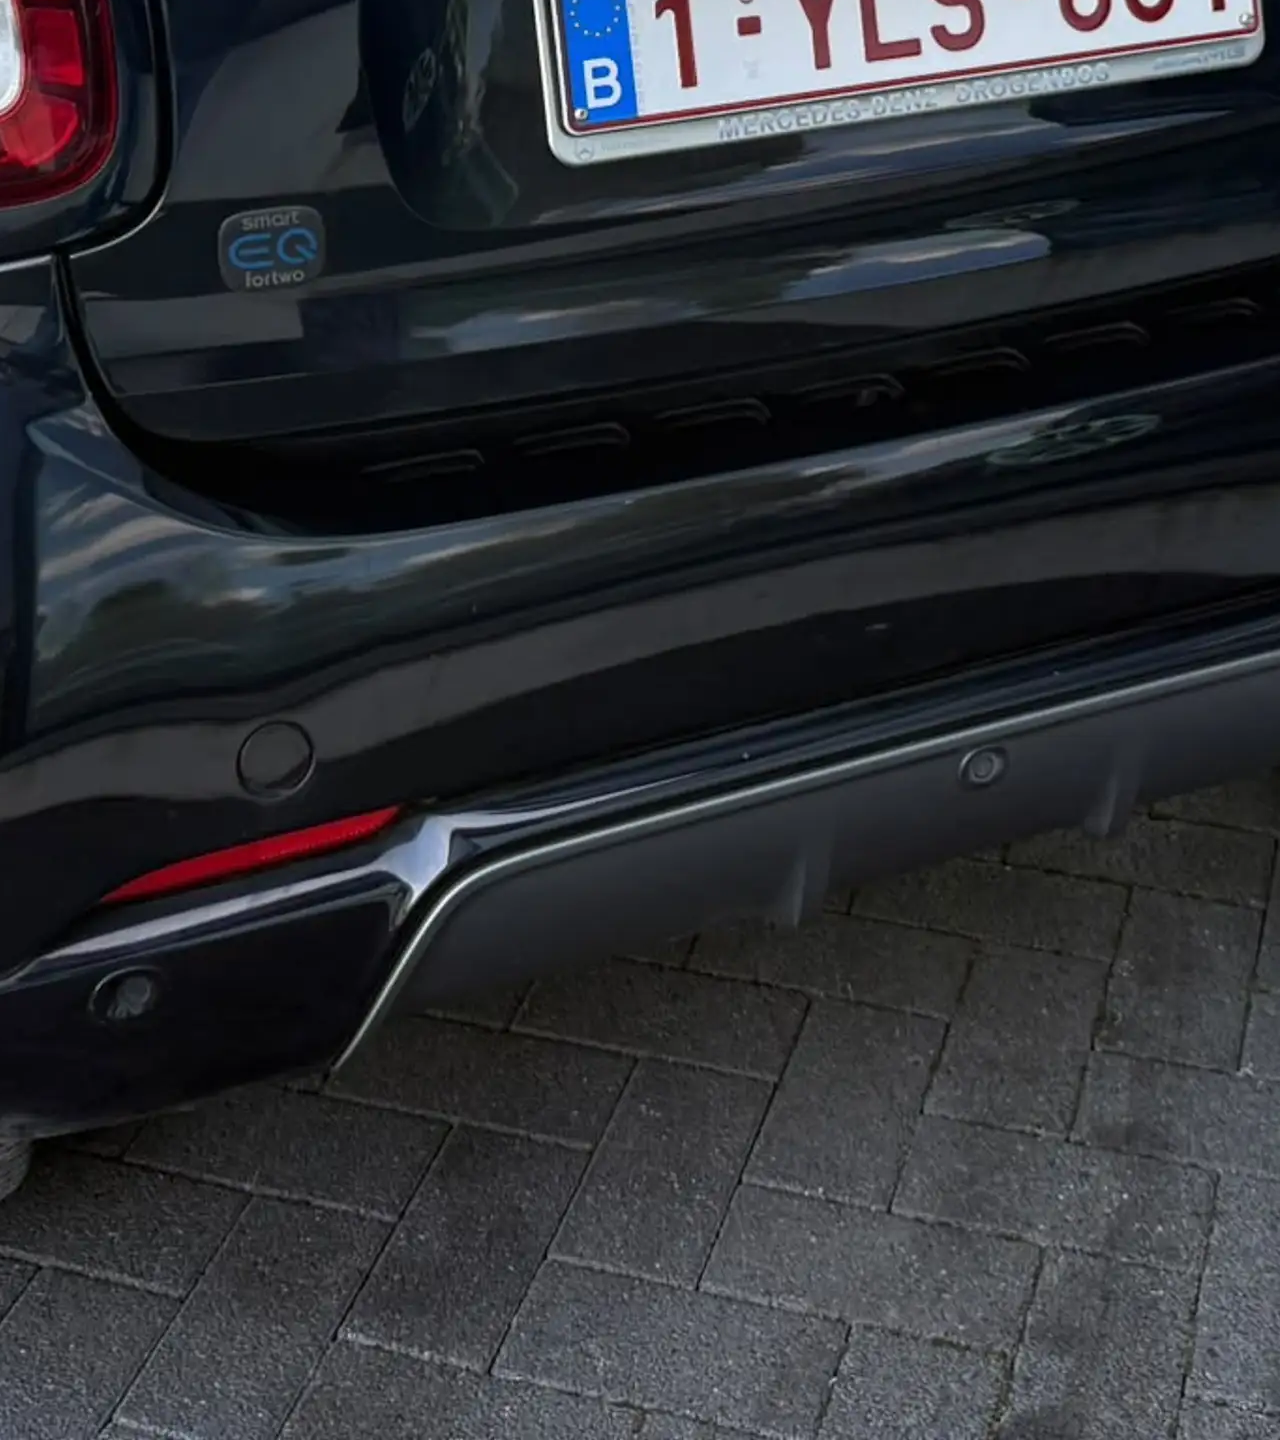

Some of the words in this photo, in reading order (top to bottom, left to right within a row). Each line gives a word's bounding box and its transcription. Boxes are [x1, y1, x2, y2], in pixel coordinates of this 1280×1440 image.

[582, 56, 622, 110] B
[717, 86, 939, 139] MERCEDES-BENZ
[954, 62, 1109, 104] DROGENBOS
[241, 211, 300, 231] smart
[228, 227, 318, 270] EQ
[245, 269, 306, 289] fortwo
